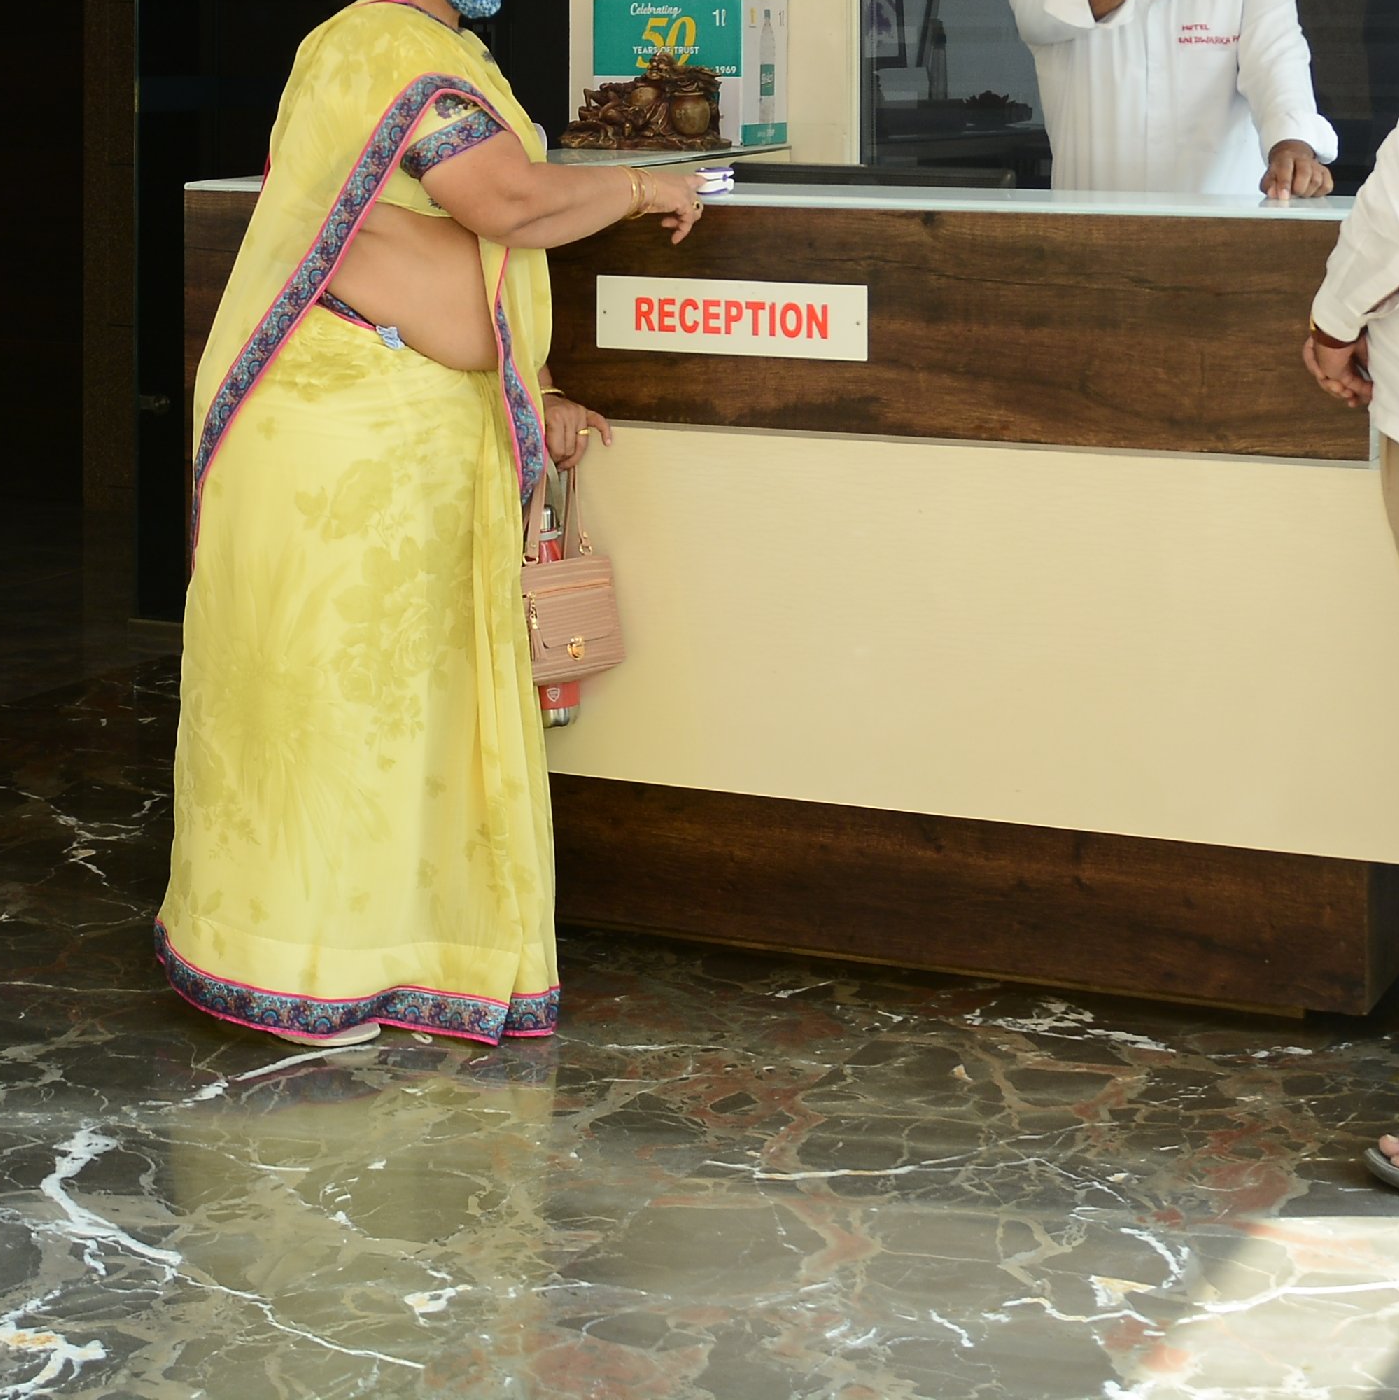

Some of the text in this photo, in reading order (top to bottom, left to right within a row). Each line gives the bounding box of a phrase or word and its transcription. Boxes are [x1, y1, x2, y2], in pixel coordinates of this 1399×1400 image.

[630, 2, 682, 19] Celebrating
[632, 46, 659, 55] YEARS
[674, 46, 700, 55] TRUST
[635, 16, 697, 69] 50
[714, 65, 737, 74] 1969
[634, 296, 829, 340] RECEPTION
